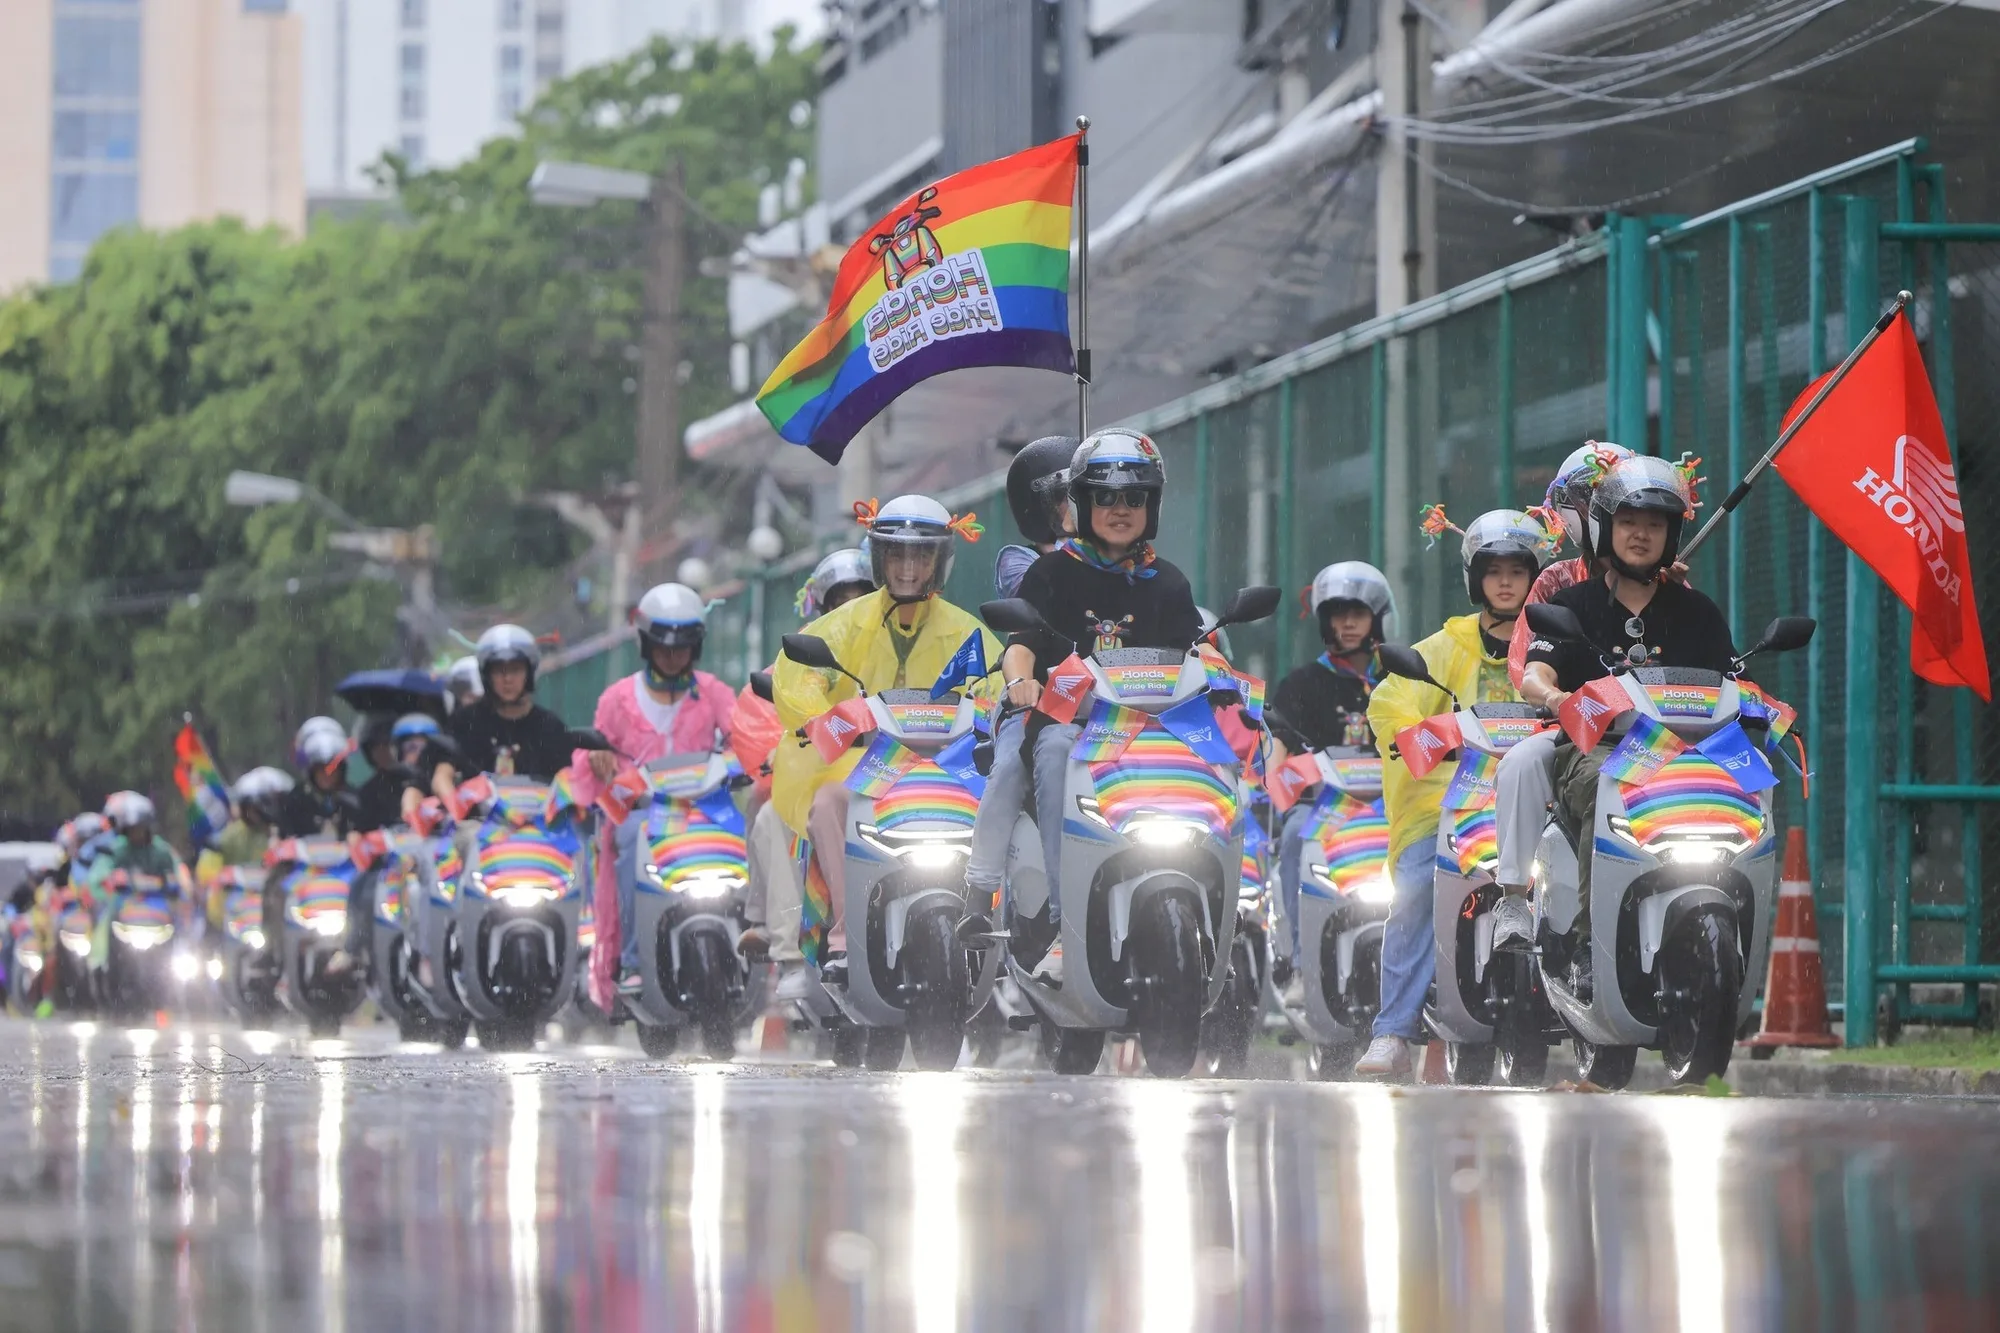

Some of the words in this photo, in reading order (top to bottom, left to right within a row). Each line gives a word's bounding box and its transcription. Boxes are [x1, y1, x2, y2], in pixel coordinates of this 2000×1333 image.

[1852, 466, 1962, 607] HONDA
[1121, 670, 1165, 680] Honda
[1147, 682, 1167, 690] Ride
[1051, 685, 1077, 704] HONDA
[1662, 689, 1706, 699] Honda
[905, 708, 944, 717] Honda
[1664, 702, 1687, 710] Pride
[1688, 702, 1707, 710] Ride
[1573, 702, 1598, 733] HONDA
[823, 720, 843, 748] HONDA
[1091, 723, 1132, 738] Honda
[1188, 731, 1213, 744] EV
[1413, 733, 1433, 763] HONDA
[1628, 737, 1666, 762] Honda
[869, 753, 902, 776] Honda
[1726, 755, 1751, 770] EV
